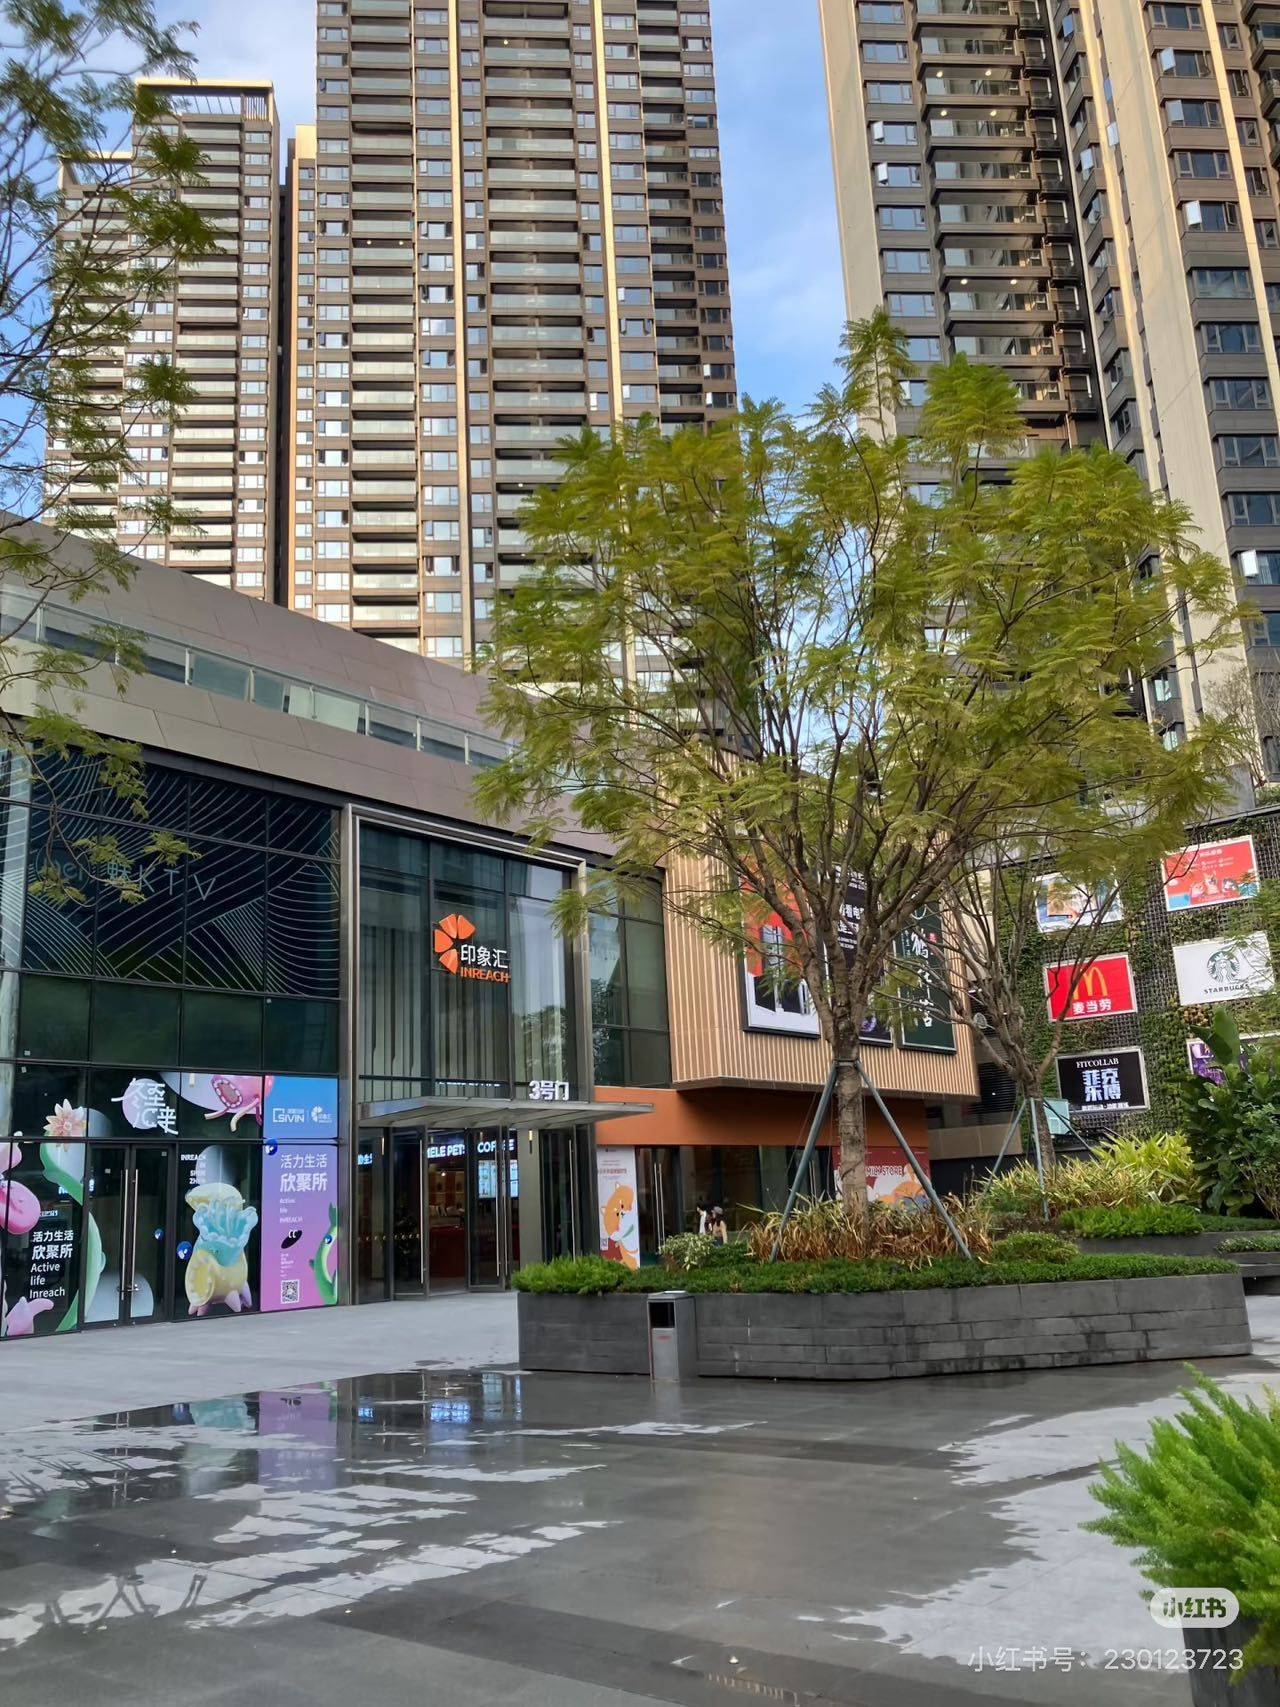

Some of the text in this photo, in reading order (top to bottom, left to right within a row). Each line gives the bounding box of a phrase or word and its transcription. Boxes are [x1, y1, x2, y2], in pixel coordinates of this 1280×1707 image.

[461, 944, 508, 969] 印象汇
[461, 967, 509, 983] INREACH
[1073, 999, 1112, 1015] 麦当劳
[529, 1080, 569, 1101] 3号门
[280, 1153, 328, 1169] 活力生活
[280, 1172, 328, 1192] 欣聚所
[33, 1230, 74, 1242] 活力生活
[32, 1244, 73, 1260] 欣聚所
[31, 1262, 61, 1273] Active
[30, 1276, 46, 1286] life
[29, 1287, 66, 1299] Inreach
